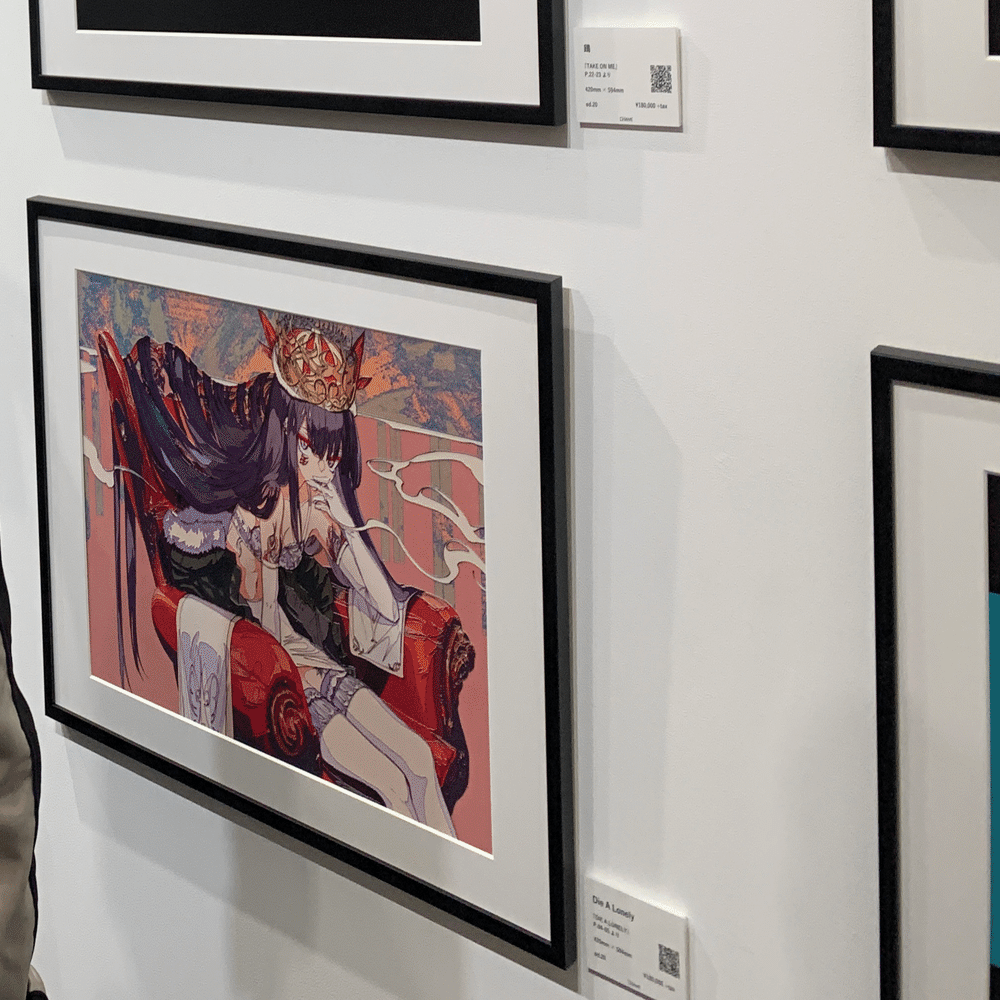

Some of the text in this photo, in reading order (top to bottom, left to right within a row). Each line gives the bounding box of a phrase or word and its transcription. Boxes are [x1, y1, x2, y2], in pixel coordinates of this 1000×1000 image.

[592, 895, 635, 922] Die A Lonely
